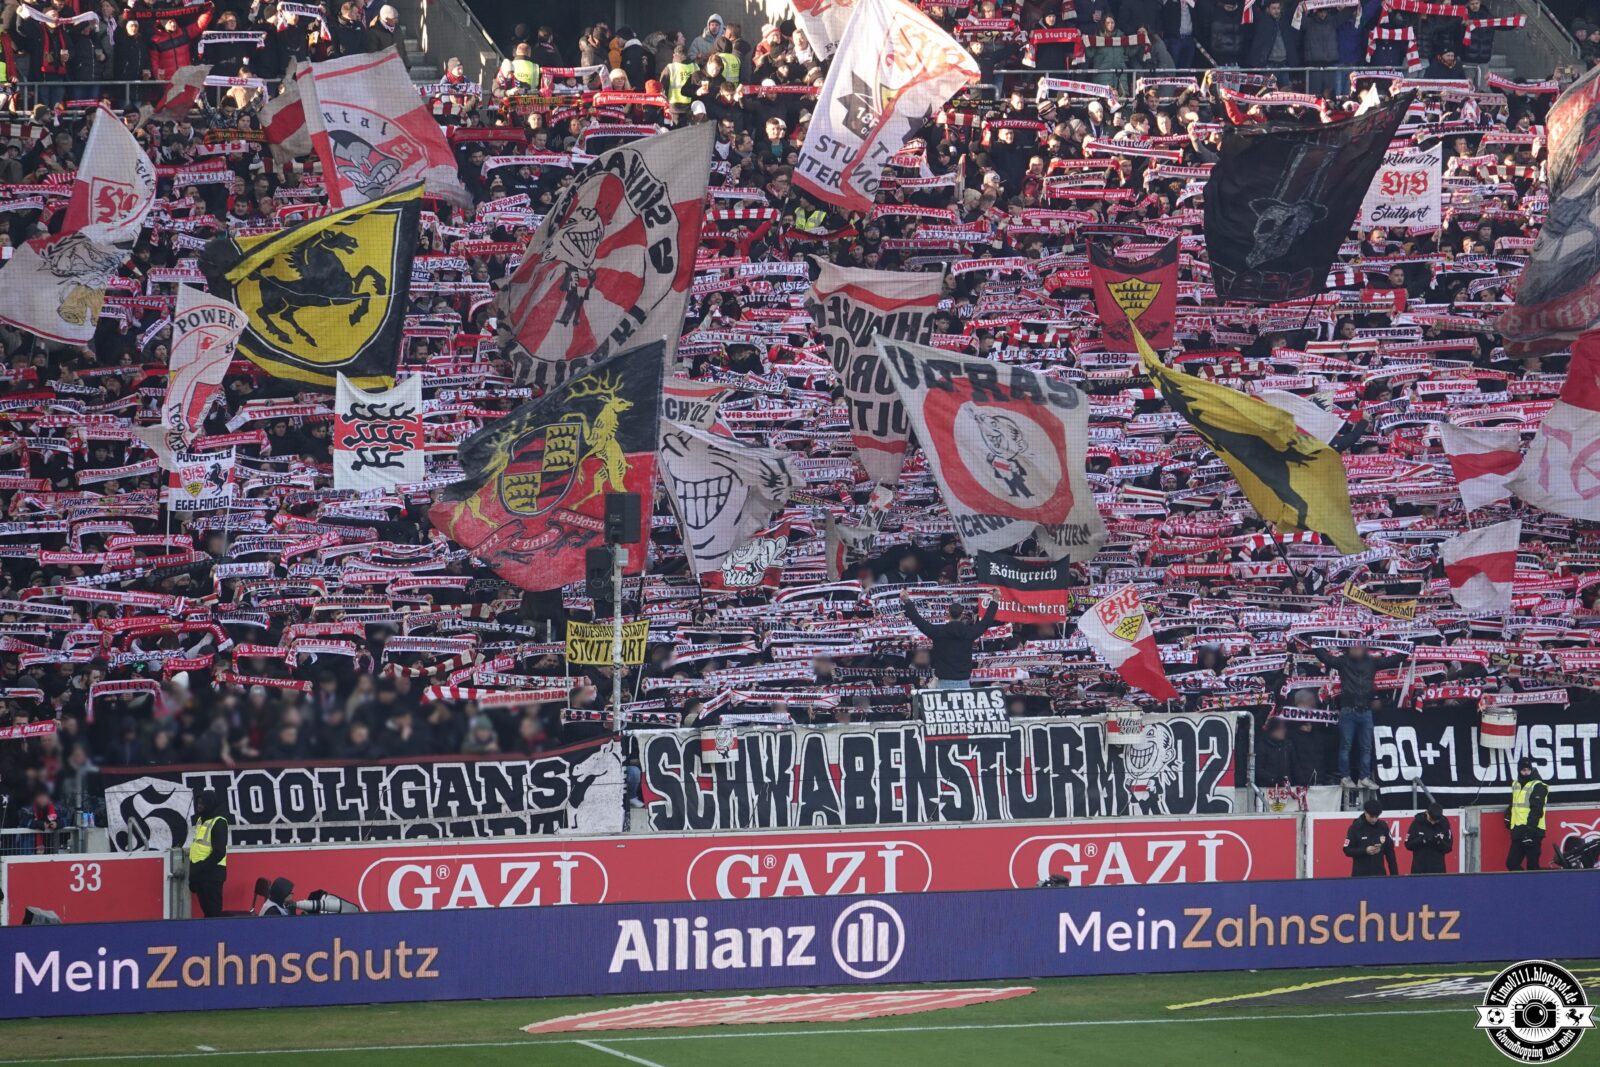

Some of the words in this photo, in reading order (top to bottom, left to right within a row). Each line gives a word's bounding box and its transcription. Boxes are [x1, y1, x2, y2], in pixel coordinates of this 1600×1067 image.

[155, 7, 200, 17] CANNSTATT
[1003, 120, 1039, 128] STUTTGART
[1380, 169, 1429, 196] VfB
[1370, 203, 1431, 223] Stuttgart
[1358, 329, 1416, 338] STUTTGART
[1096, 354, 1128, 363] 1893
[422, 375, 477, 386] Krombacher
[1275, 379, 1307, 387] Stuttgart
[1420, 382, 1435, 391] VfB
[248, 406, 317, 418] STUTTGART
[724, 411, 743, 419] VfB
[745, 411, 793, 420] Stuttgart
[175, 495, 230, 511] EGELFINGEN
[989, 562, 1057, 583] Königreich
[1187, 564, 1229, 575] STUTTGART
[1250, 565, 1288, 575] VfB
[30, 605, 72, 616] STADION
[1160, 618, 1226, 627] STUTTGART
[570, 622, 648, 638] LANDESHAUSTADT
[1315, 639, 1356, 647] STUTTGART
[568, 638, 645, 661] STUTTART
[971, 668, 1017, 679] TTGART
[232, 675, 247, 683] VfB
[249, 676, 296, 687] STUTTGART
[923, 690, 1005, 711] ULTRAS
[924, 708, 1007, 723] BEDEUTET
[925, 720, 1011, 737] WIDERSTAND
[1372, 725, 1458, 782] 50+1
[644, 722, 1132, 831] SCHWABENSTURM
[1169, 715, 1236, 815] 02
[181, 756, 573, 827] HOOLIGANS
[69, 862, 102, 892] 33
[608, 916, 817, 974] Allianz
